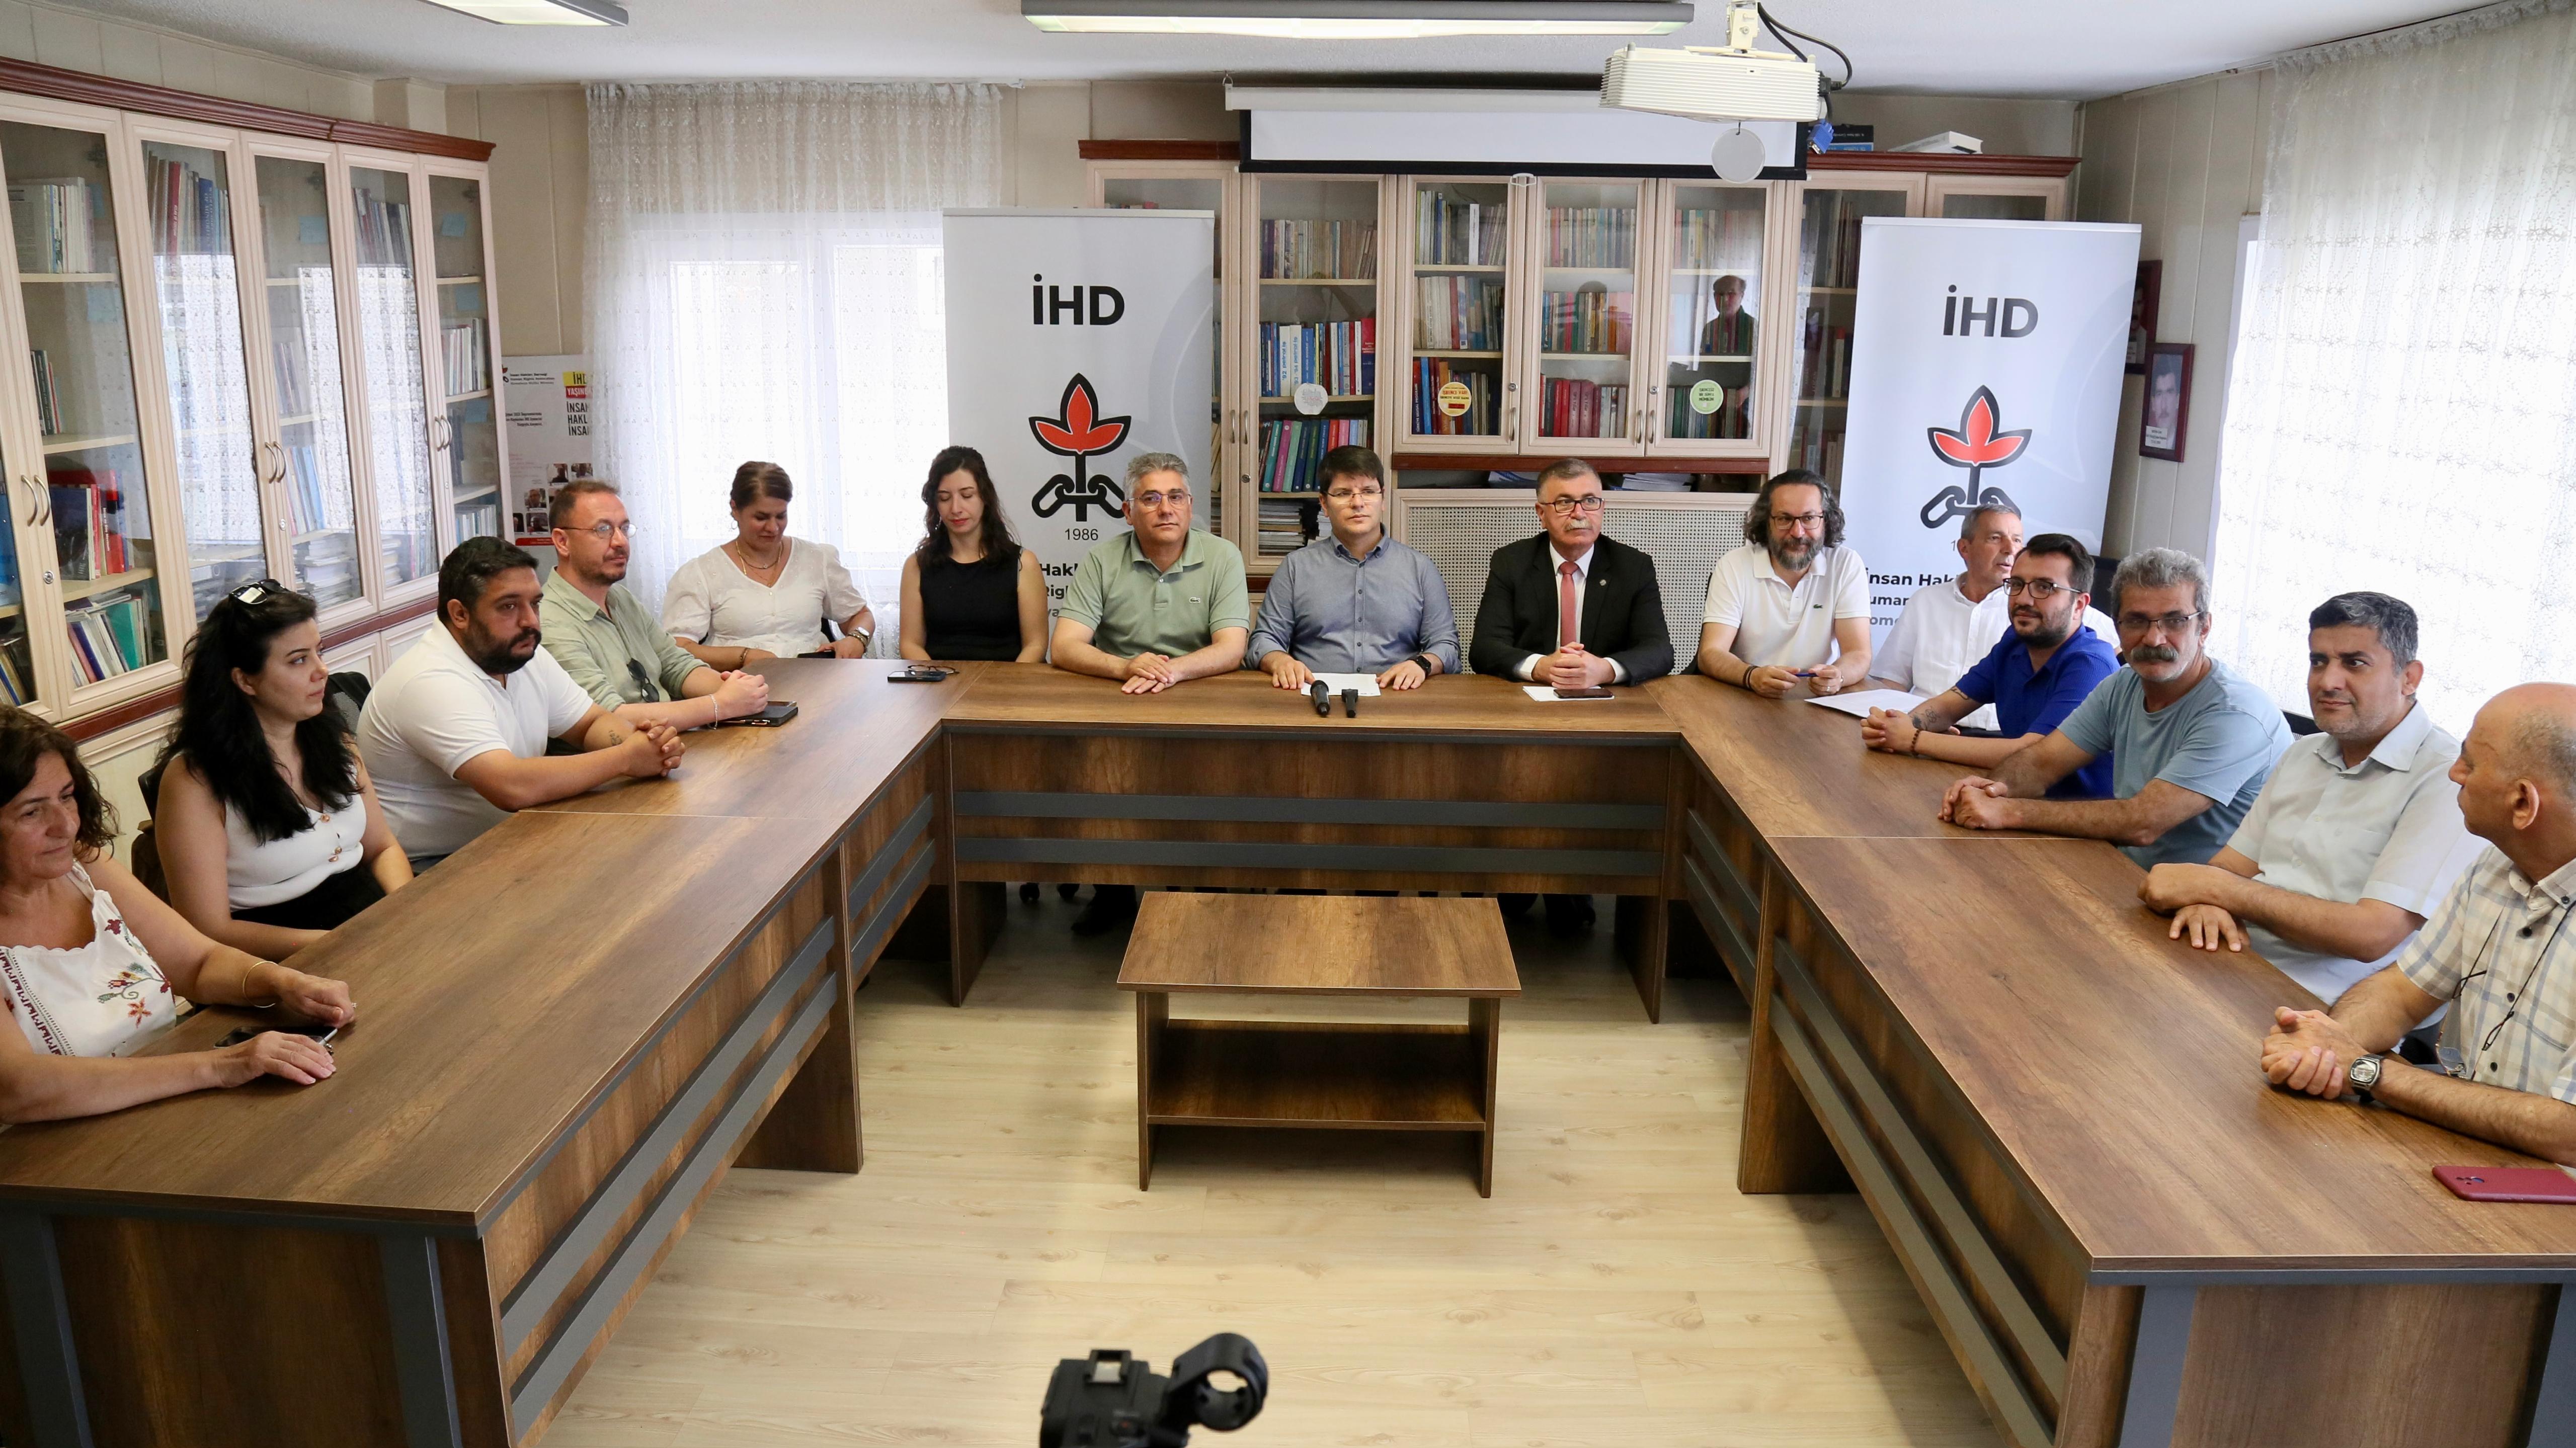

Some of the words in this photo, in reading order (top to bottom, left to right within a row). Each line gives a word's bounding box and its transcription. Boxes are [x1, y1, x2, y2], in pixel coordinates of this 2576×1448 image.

[1033, 274, 1124, 325] İHD
[1943, 285, 2038, 338] İHD
[568, 414, 588, 424] HAKL
[1065, 528, 1098, 541] 1986
